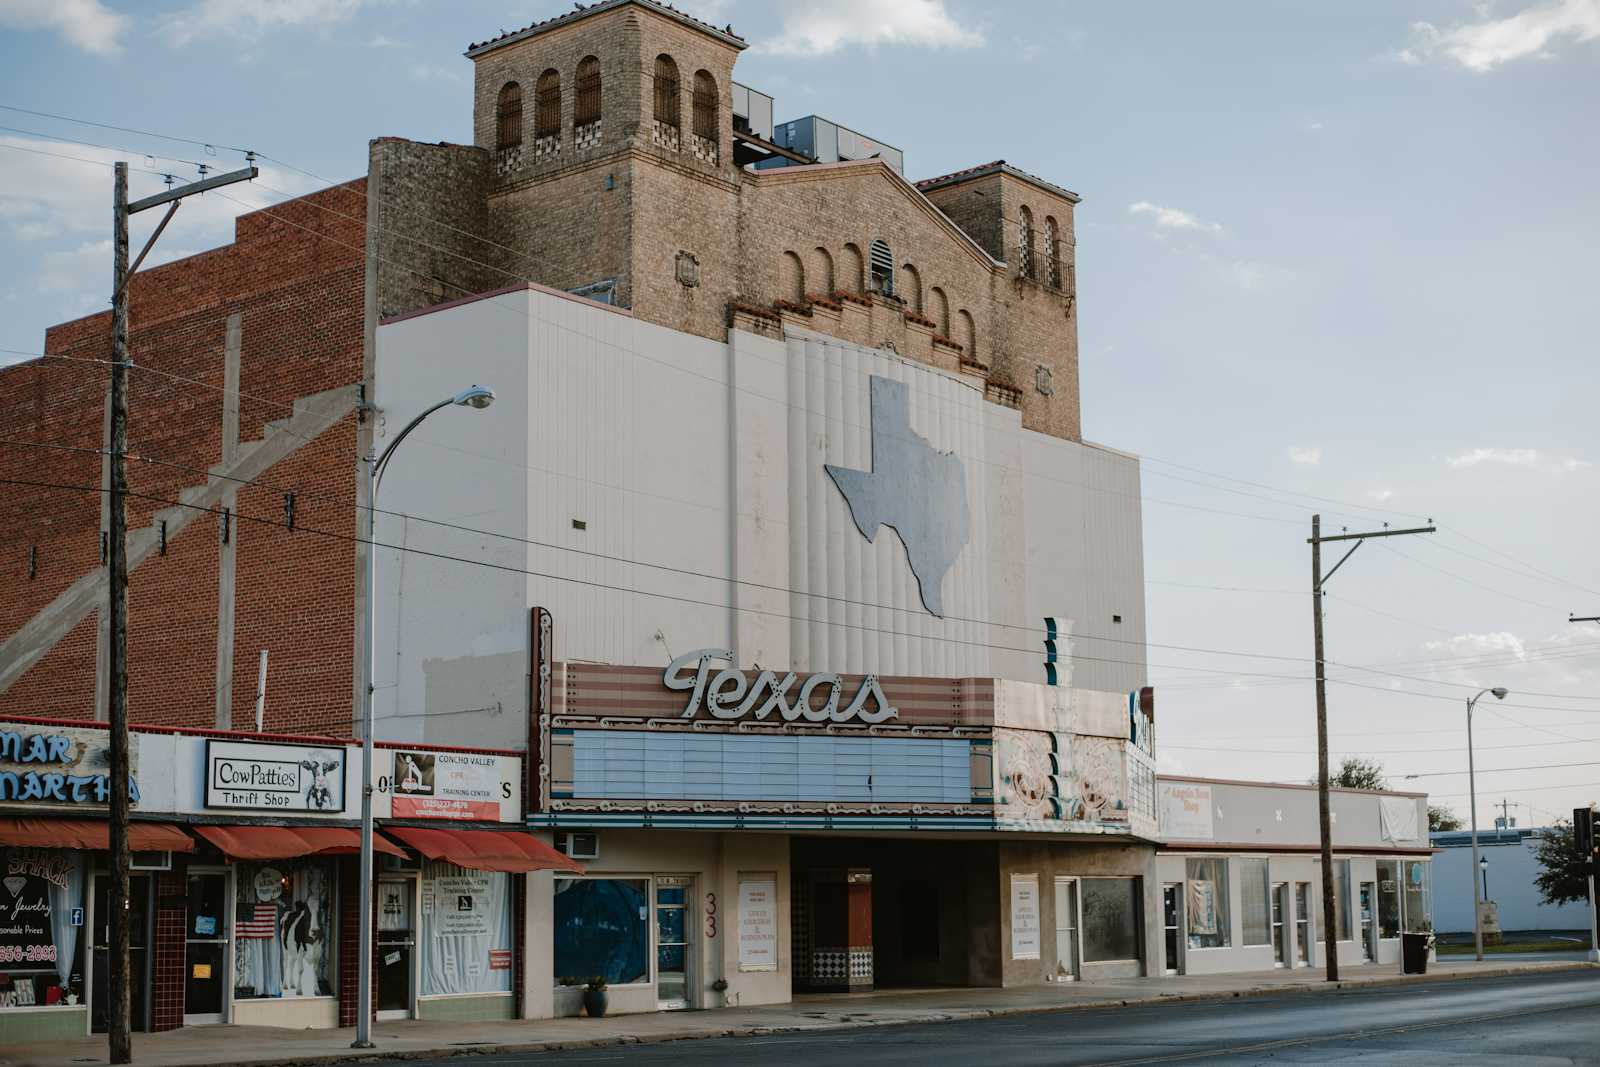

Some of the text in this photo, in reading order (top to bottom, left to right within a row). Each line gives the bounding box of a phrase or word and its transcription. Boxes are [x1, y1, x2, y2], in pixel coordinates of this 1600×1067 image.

[663, 648, 899, 723] Texas
[438, 755, 496, 766] CONCHO VALLEY
[219, 762, 296, 787] CowPatties
[223, 792, 290, 806] Thrift Shop
[442, 788, 491, 797] TRAINING CENTER
[10, 896, 52, 920] Jewelry
[25, 924, 44, 935] Prices
